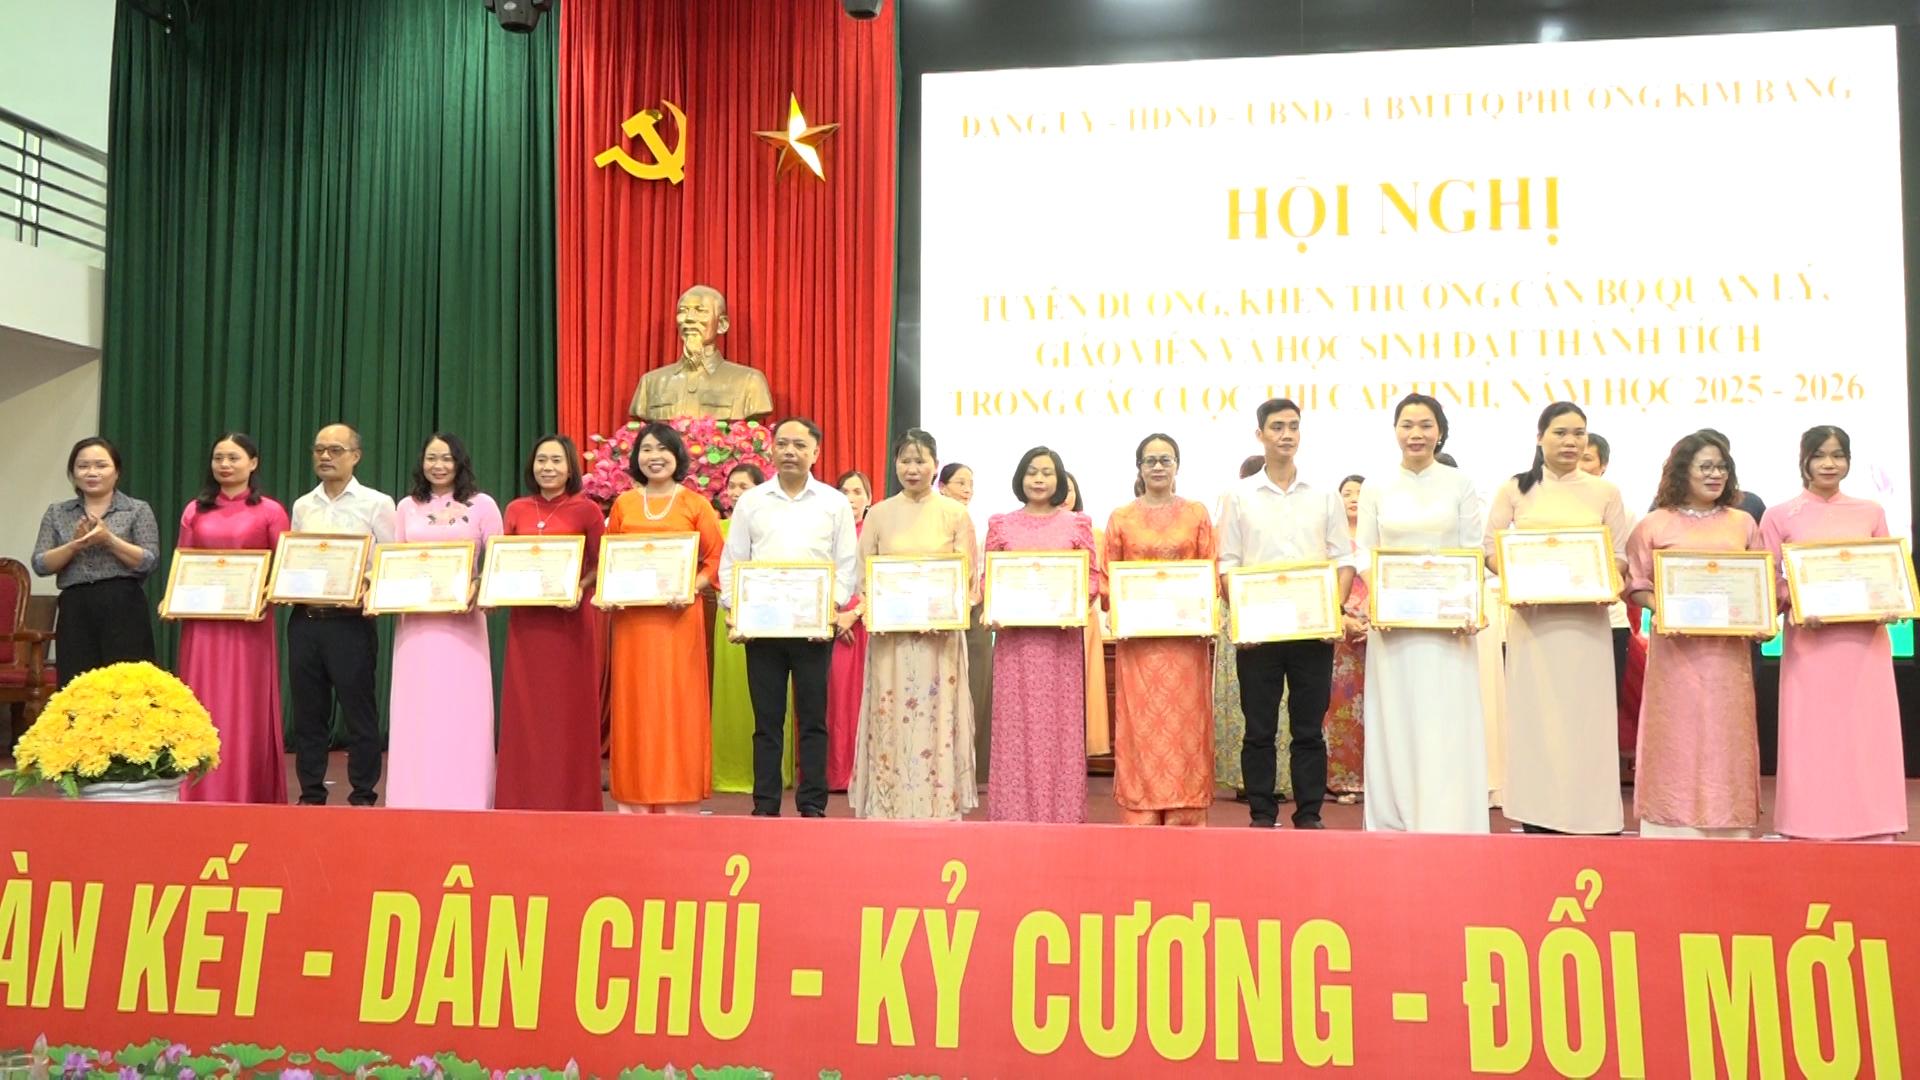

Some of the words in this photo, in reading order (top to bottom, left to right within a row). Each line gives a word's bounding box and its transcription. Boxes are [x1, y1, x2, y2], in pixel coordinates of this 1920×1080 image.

[1673, 79, 1744, 109] KIM
[1226, 177, 1350, 255] HỘI
[1378, 175, 1559, 247] NGHỊ
[1694, 374, 1764, 405] 2025
[1794, 370, 1866, 404] 2026
[117, 843, 283, 1017] KẾT
[302, 950, 333, 977] -
[358, 864, 549, 1030] DÂN
[574, 853, 761, 1041] CHỦ
[790, 968, 823, 997] -
[855, 859, 981, 1049] KỶ
[1011, 900, 1355, 1067] CƯƠNG
[1391, 992, 1428, 1022] -
[1462, 868, 1647, 1080] ĐỔI
[1679, 903, 1903, 1080] MỚI
